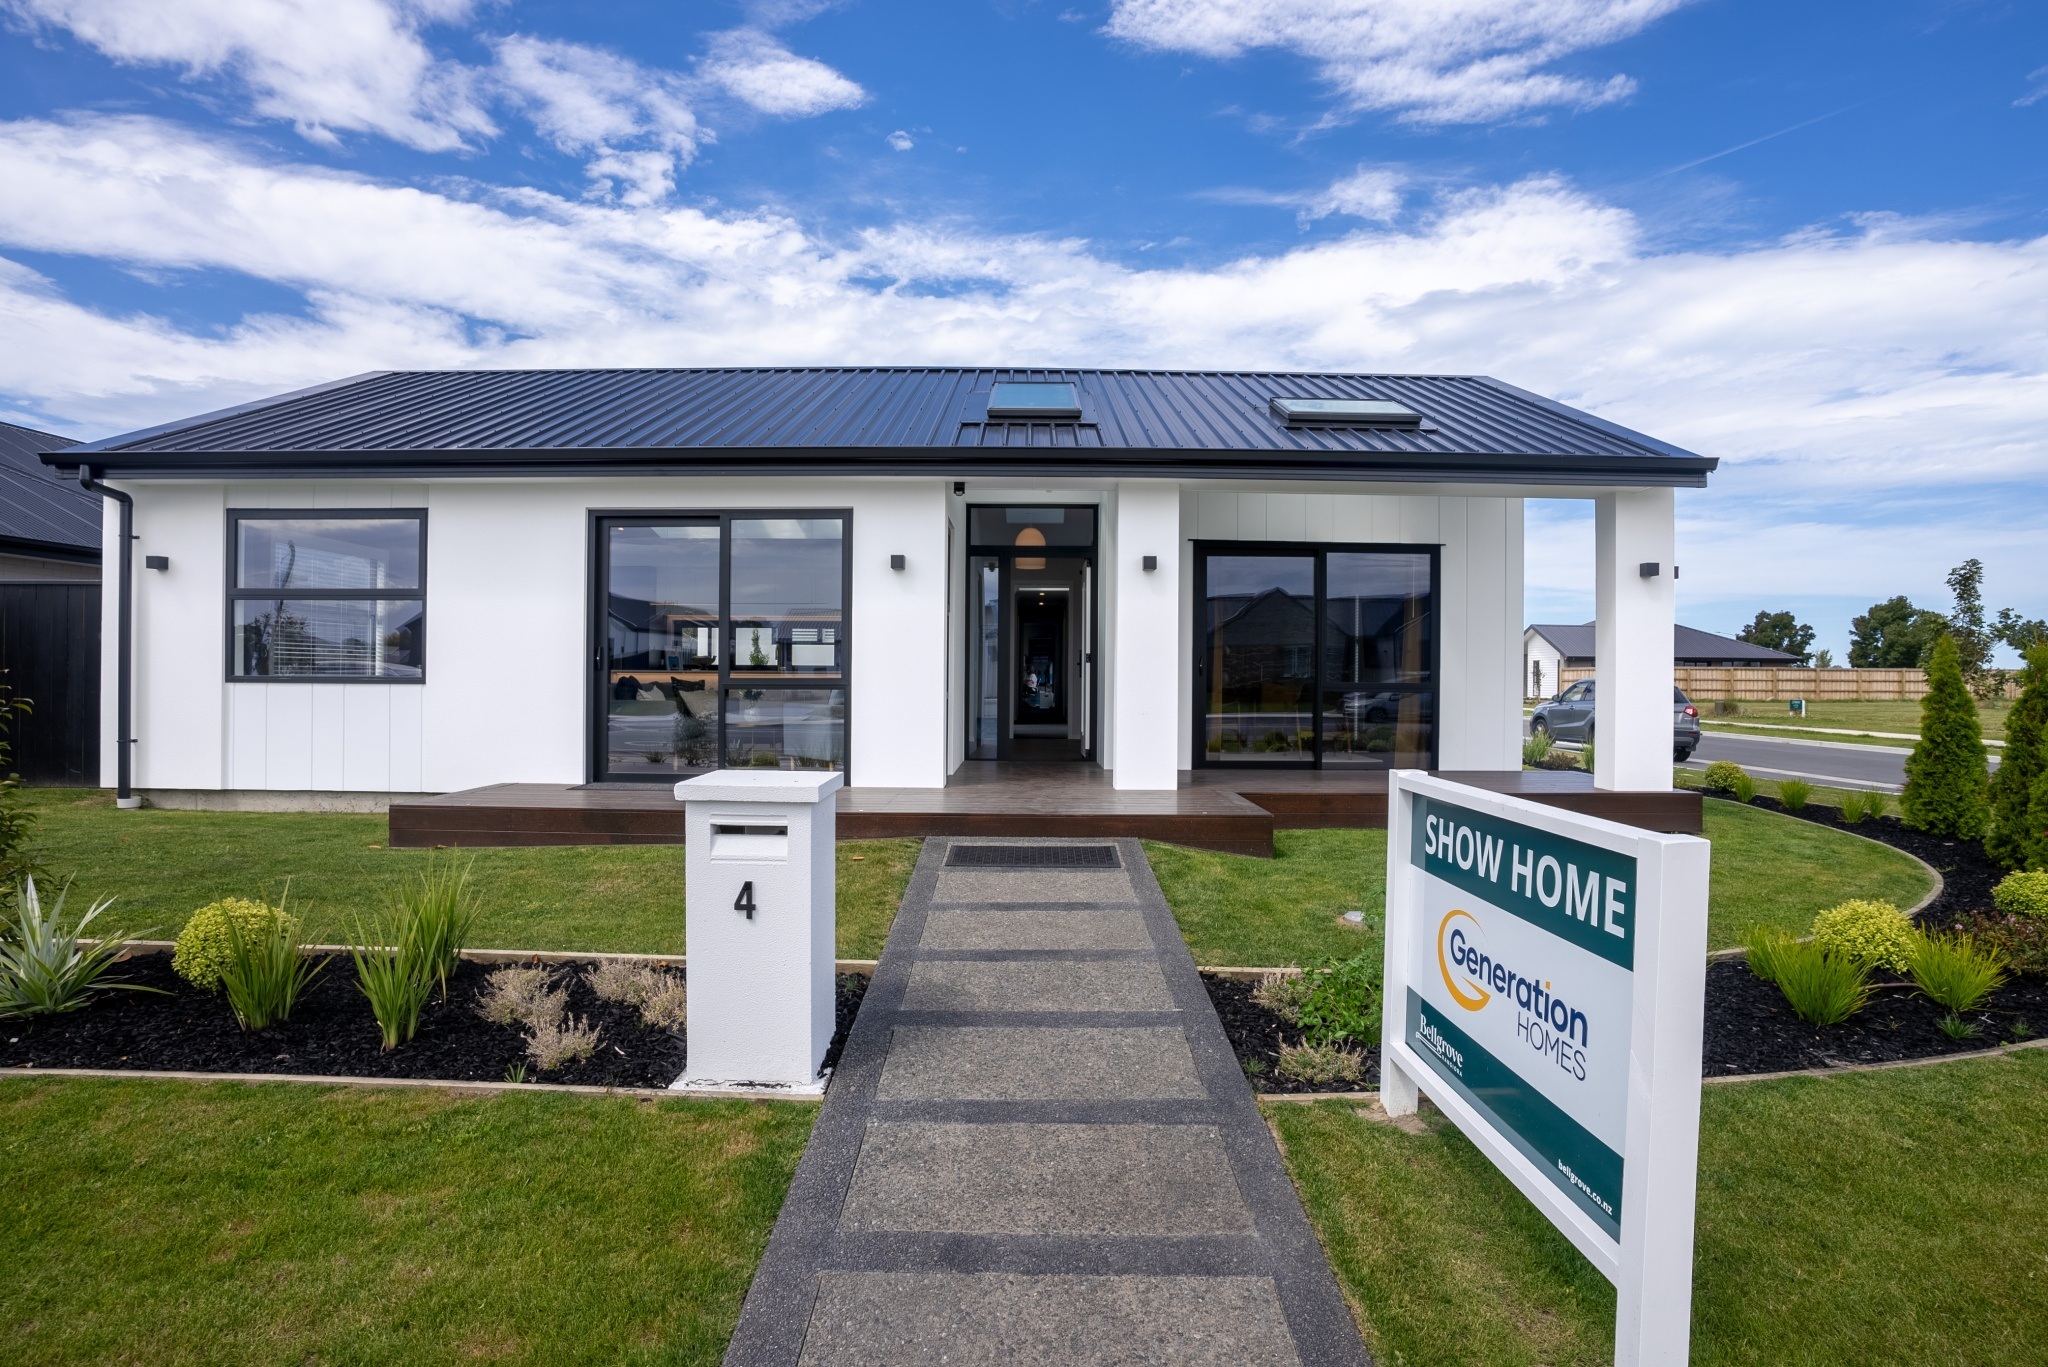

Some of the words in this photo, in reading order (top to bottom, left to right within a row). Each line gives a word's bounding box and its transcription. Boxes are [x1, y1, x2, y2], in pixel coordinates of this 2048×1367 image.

[733, 880, 756, 920] 4
[1425, 814, 1504, 883] SHOW
[1511, 844, 1627, 939] HOME
[1450, 929, 1588, 1048] Generation
[1420, 1012, 1463, 1068] Bellgrove
[1517, 1011, 1586, 1081] HOMES
[1558, 1158, 1613, 1216] bellgrove.co.nz
